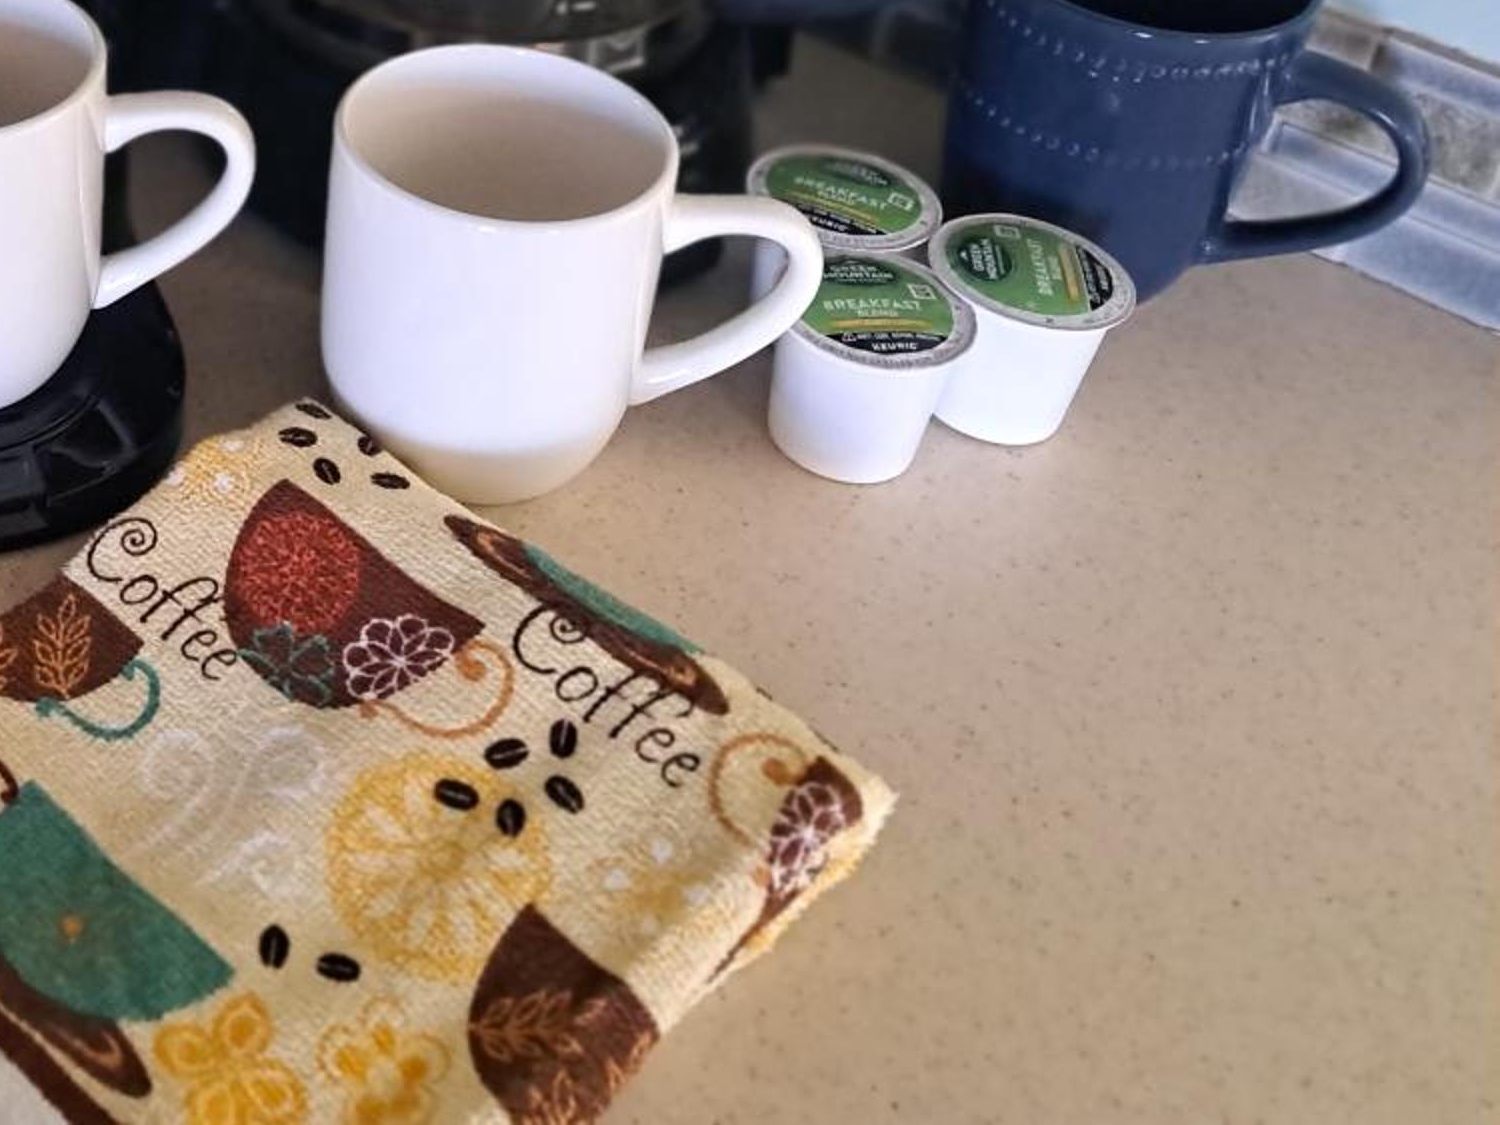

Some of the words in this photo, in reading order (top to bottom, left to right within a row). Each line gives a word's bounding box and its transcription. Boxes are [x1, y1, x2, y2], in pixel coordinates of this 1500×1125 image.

[823, 298, 922, 312] BREAKFAST
[87, 517, 238, 681] Coffee
[513, 604, 700, 788] Coffee
